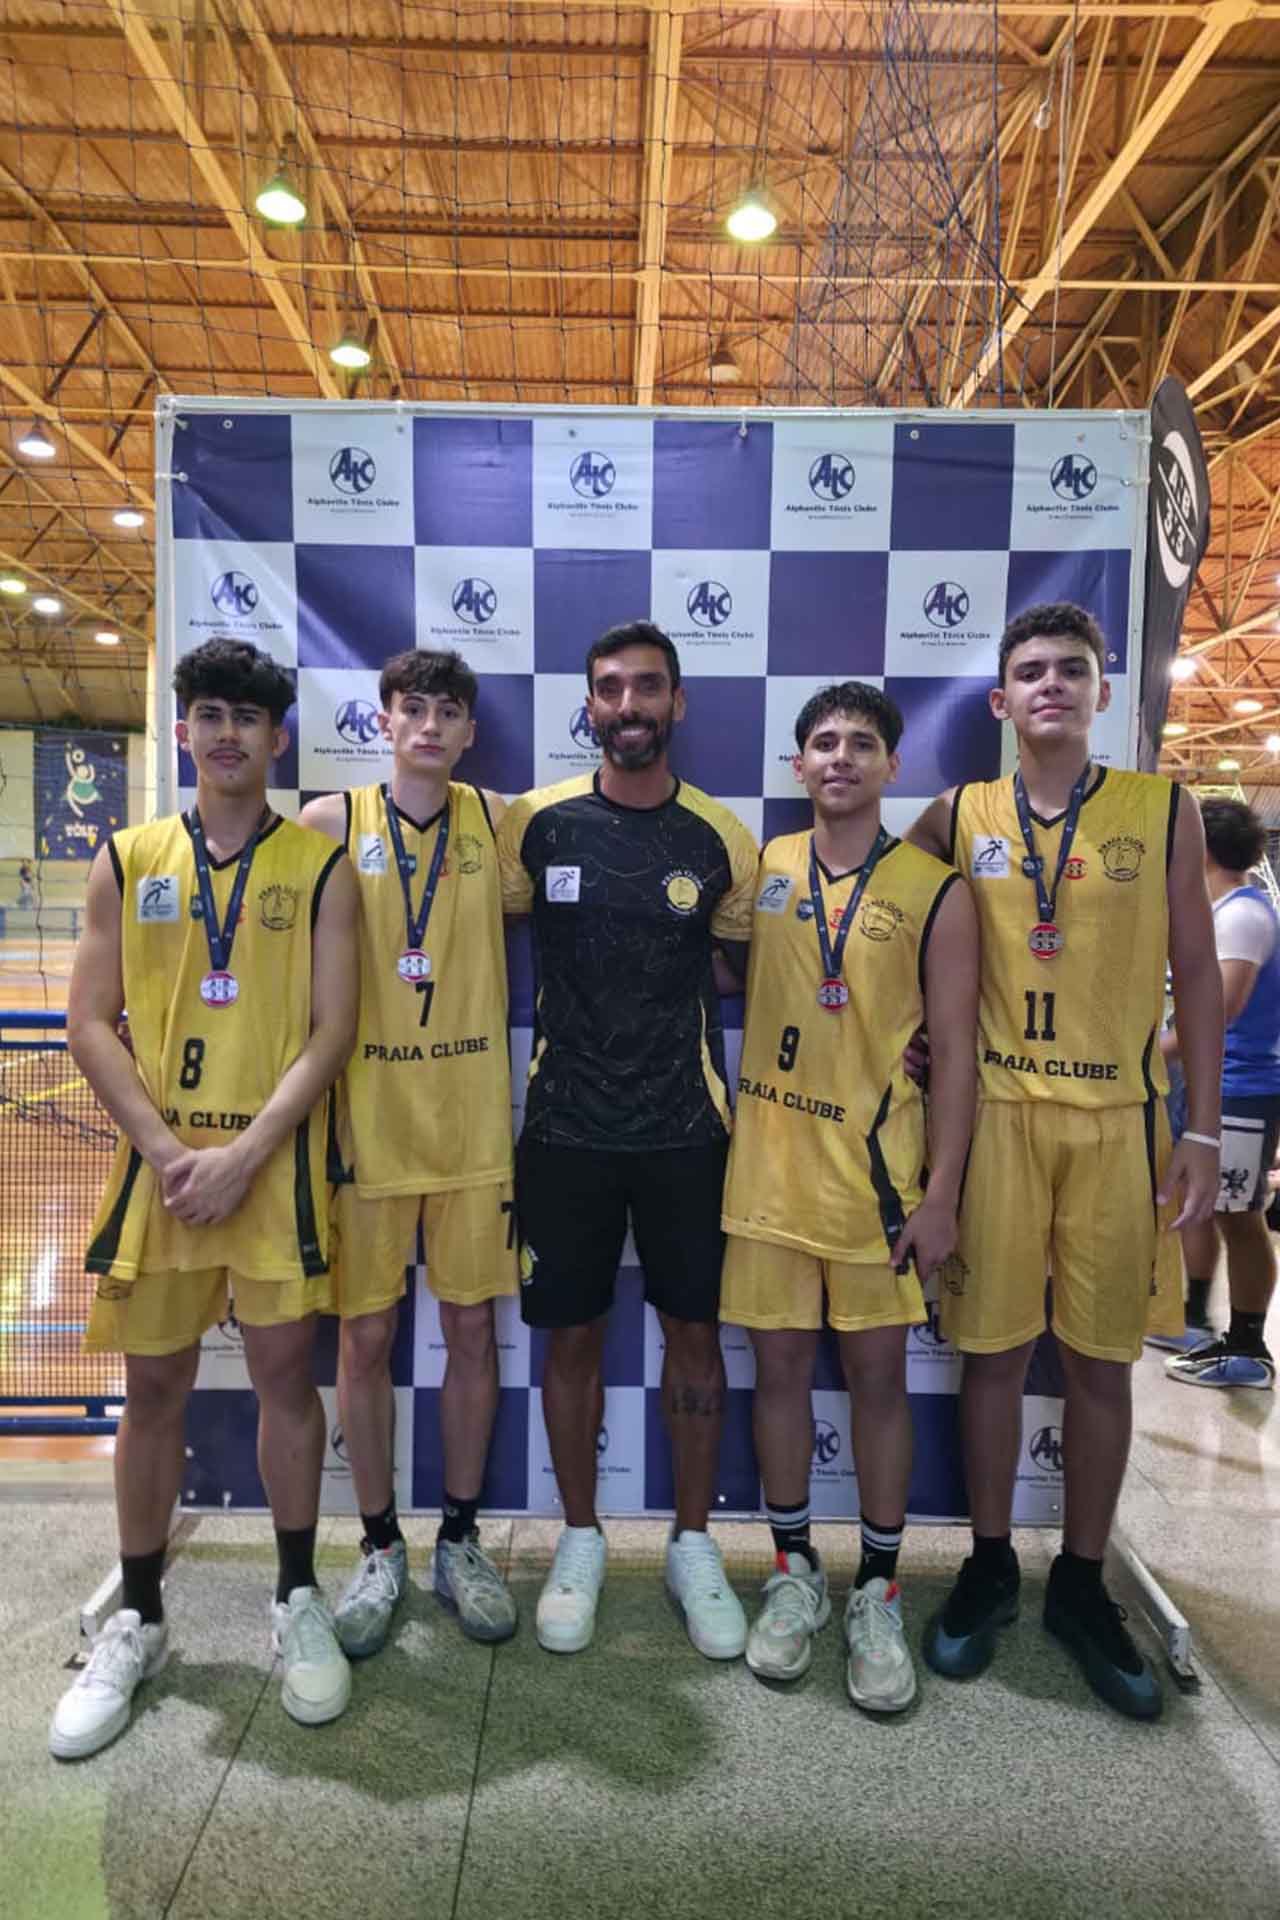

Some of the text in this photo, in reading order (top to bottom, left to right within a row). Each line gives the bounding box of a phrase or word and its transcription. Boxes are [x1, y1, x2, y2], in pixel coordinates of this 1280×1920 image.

[415, 981, 435, 1027] 7
[1024, 991, 1056, 1041] 11
[179, 1037, 205, 1089] 8
[363, 1036, 489, 1062] PRAIA CLUBE
[778, 1025, 800, 1072] 9
[1044, 1059, 1119, 1081] CLUBE
[189, 1111, 257, 1130] CLUB
[738, 1077, 846, 1123] RAIA CLUBE
